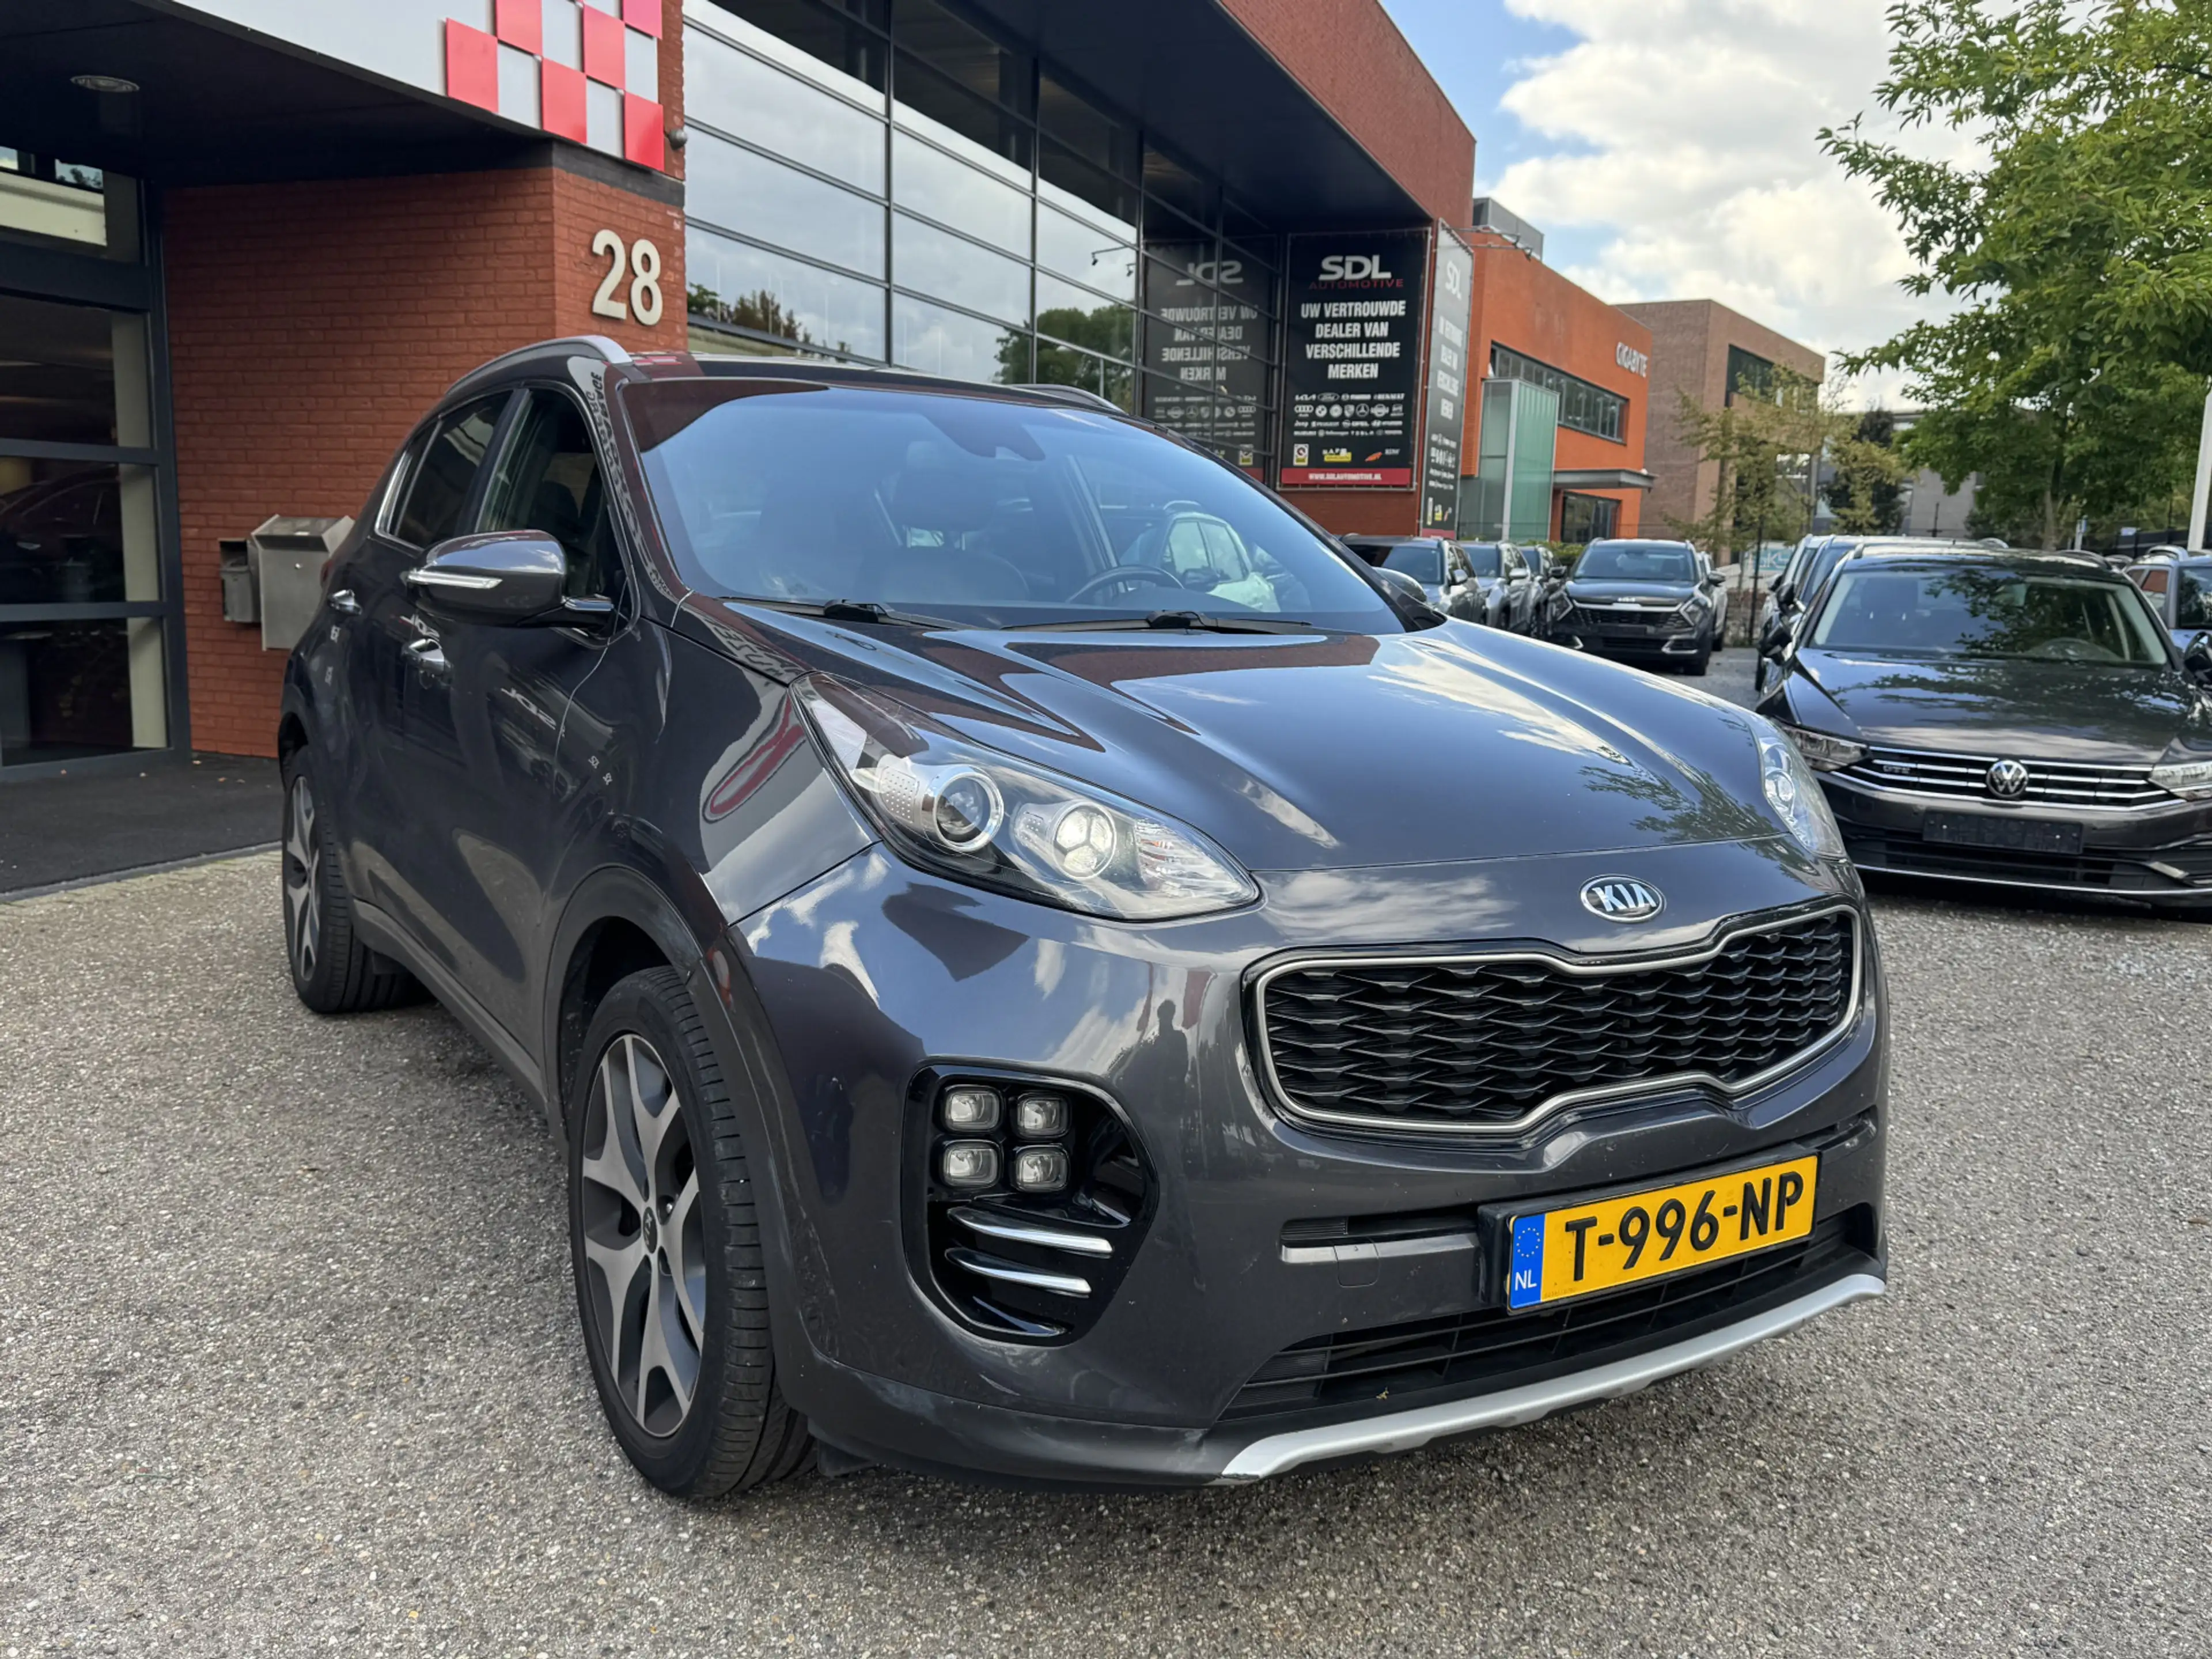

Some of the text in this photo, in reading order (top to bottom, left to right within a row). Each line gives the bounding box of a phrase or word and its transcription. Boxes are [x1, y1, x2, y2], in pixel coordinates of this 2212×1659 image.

[592, 229, 662, 325] 28
[1319, 253, 1392, 281] SDL
[1309, 278, 1404, 290] AUTOMOTIVE
[1301, 300, 1406, 318] UW VERTROUWDE
[1315, 321, 1389, 338] DEALER VAN
[1305, 342, 1400, 359] VERSCHILLENDE
[1328, 363, 1378, 379] MERKEN
[1592, 883, 1657, 912] KIA
[1565, 1171, 1804, 1282] T-996-NP
[1514, 1268, 1537, 1291] NL
